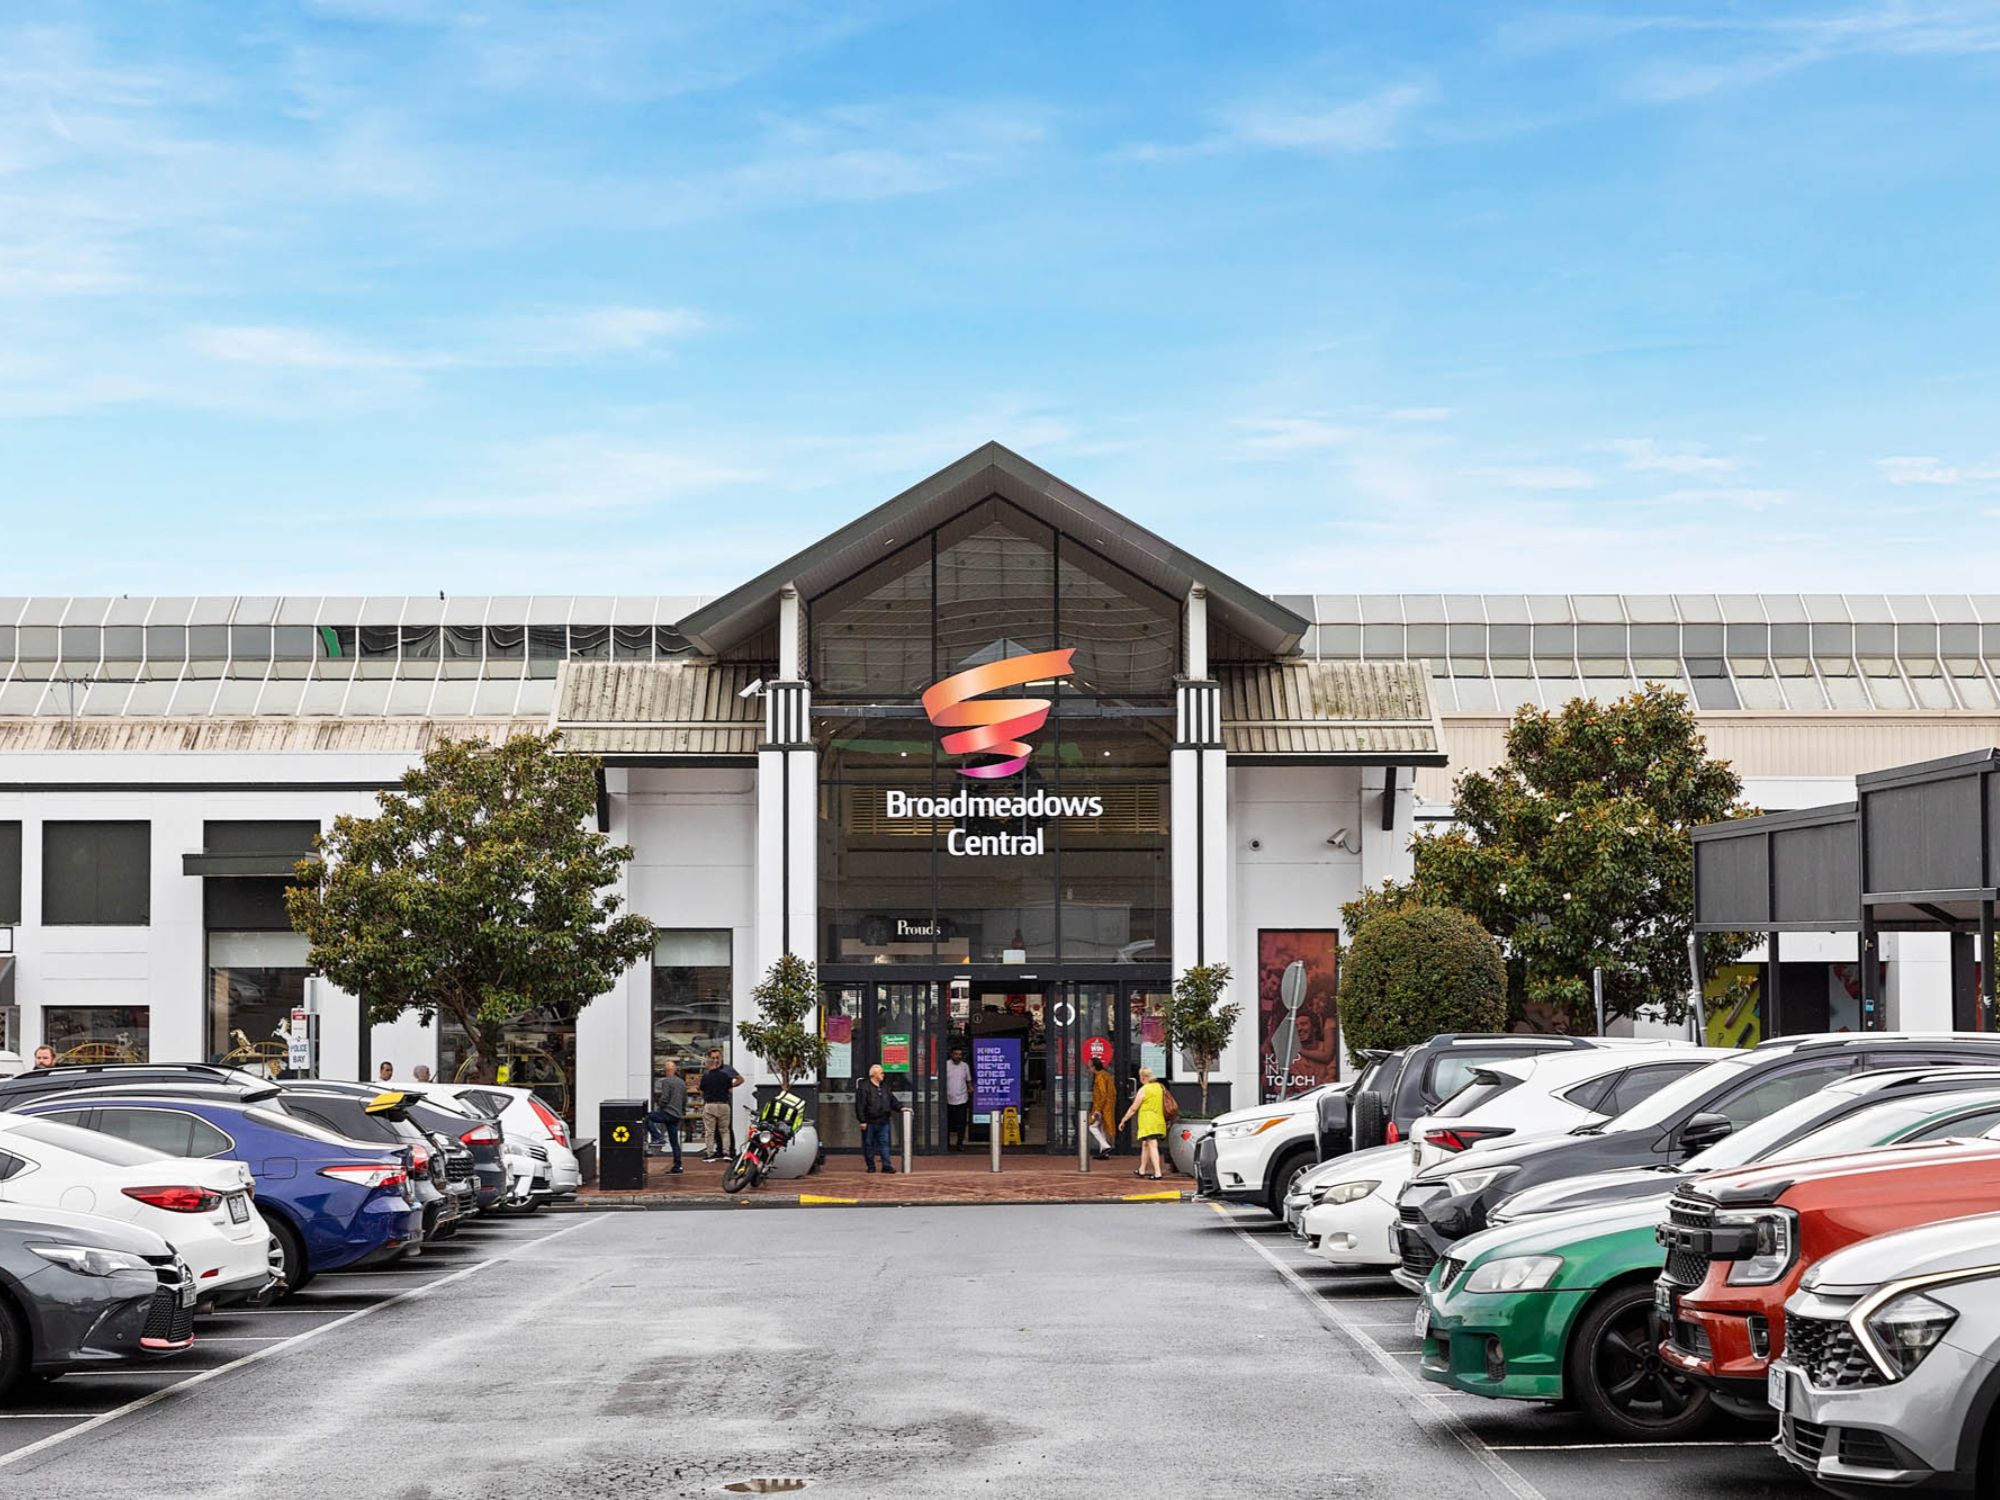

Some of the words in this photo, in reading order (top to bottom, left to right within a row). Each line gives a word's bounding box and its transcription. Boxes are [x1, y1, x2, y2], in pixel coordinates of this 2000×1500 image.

[886, 789, 1103, 818] Broadmeadows
[947, 827, 1044, 856] Central
[897, 919, 941, 936] Prouds
[290, 1044, 307, 1052] POLICE
[292, 1055, 306, 1063] BAY
[977, 1062, 1011, 1070] NEVER
[1265, 1064, 1279, 1075] IN
[977, 1070, 1006, 1078] GOES
[977, 1078, 997, 1086] OUT
[1000, 1078, 1014, 1086] OF
[1266, 1075, 1316, 1086] TOUCH
